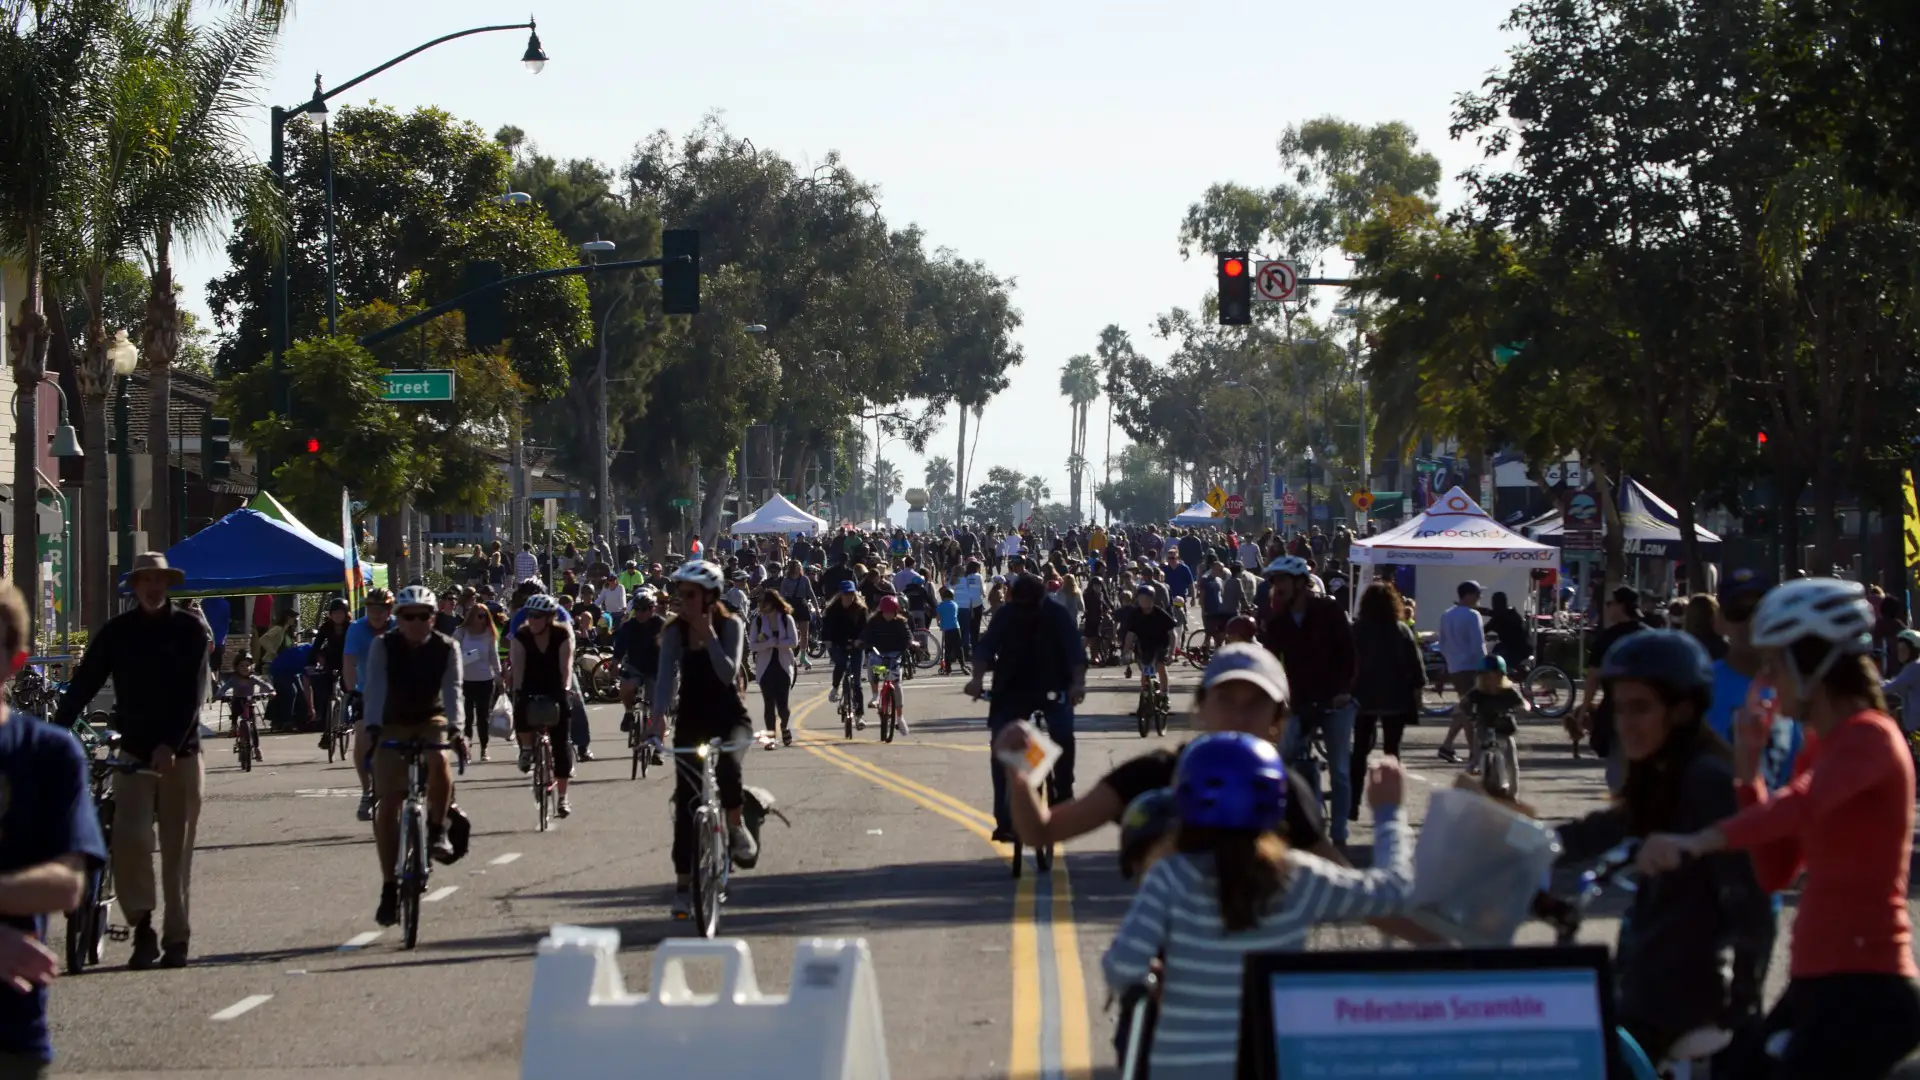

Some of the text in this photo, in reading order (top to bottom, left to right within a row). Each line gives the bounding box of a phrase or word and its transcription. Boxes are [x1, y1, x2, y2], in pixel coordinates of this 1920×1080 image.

[385, 380, 430, 394] treet
[1225, 500, 1244, 509] STOP
[1412, 529, 1511, 541] sprockids
[46, 533, 62, 588] ARK
[1492, 550, 1554, 563] sprockids
[1334, 994, 1544, 1023] Pedestrian Scramble
